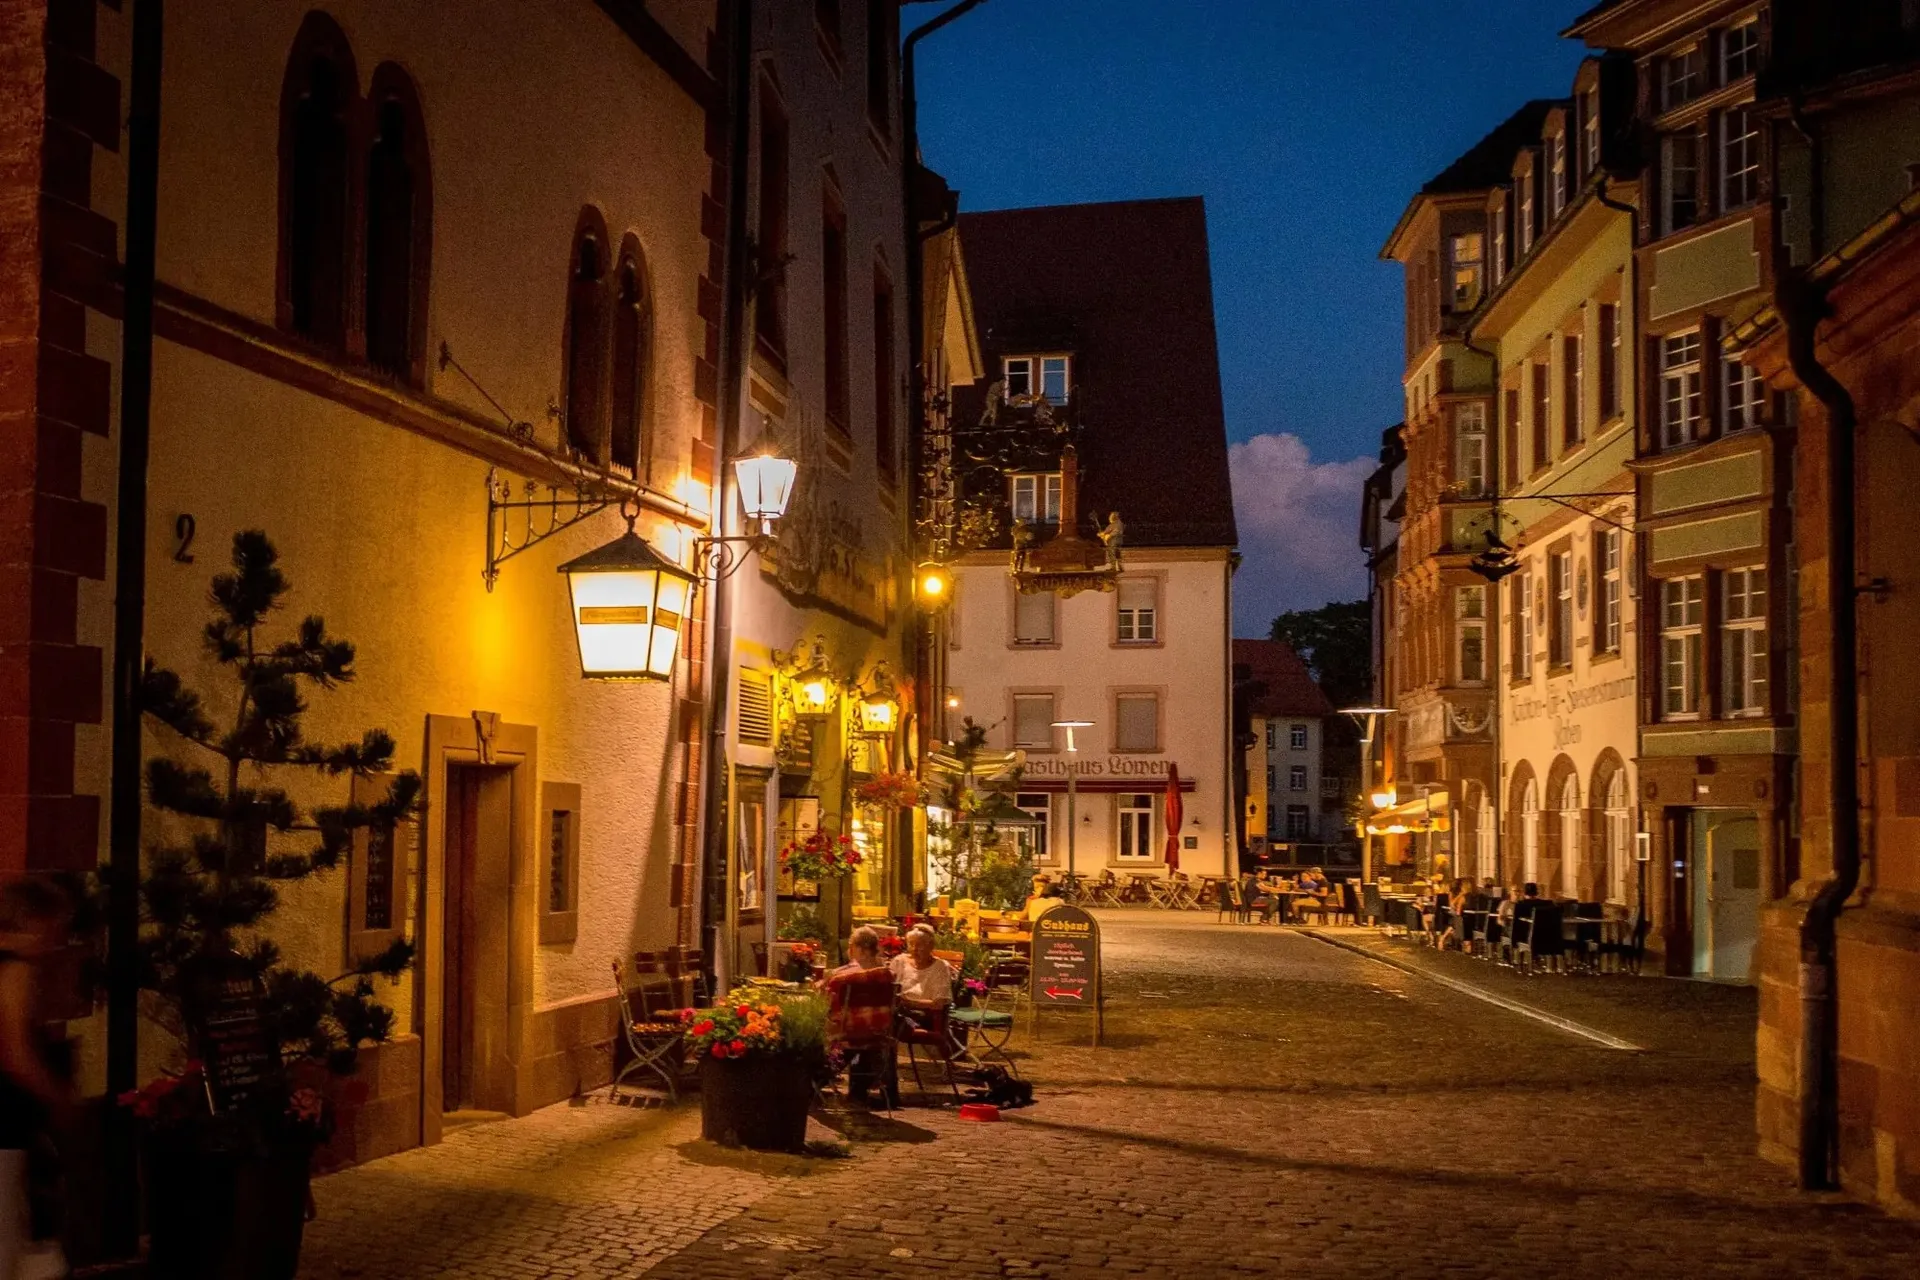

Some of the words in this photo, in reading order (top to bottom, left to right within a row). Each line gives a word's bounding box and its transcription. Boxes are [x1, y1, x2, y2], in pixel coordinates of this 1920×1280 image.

[175, 513, 195, 563] 2
[1023, 757, 1104, 776] asthus
[1108, 755, 1171, 776] Löwen
